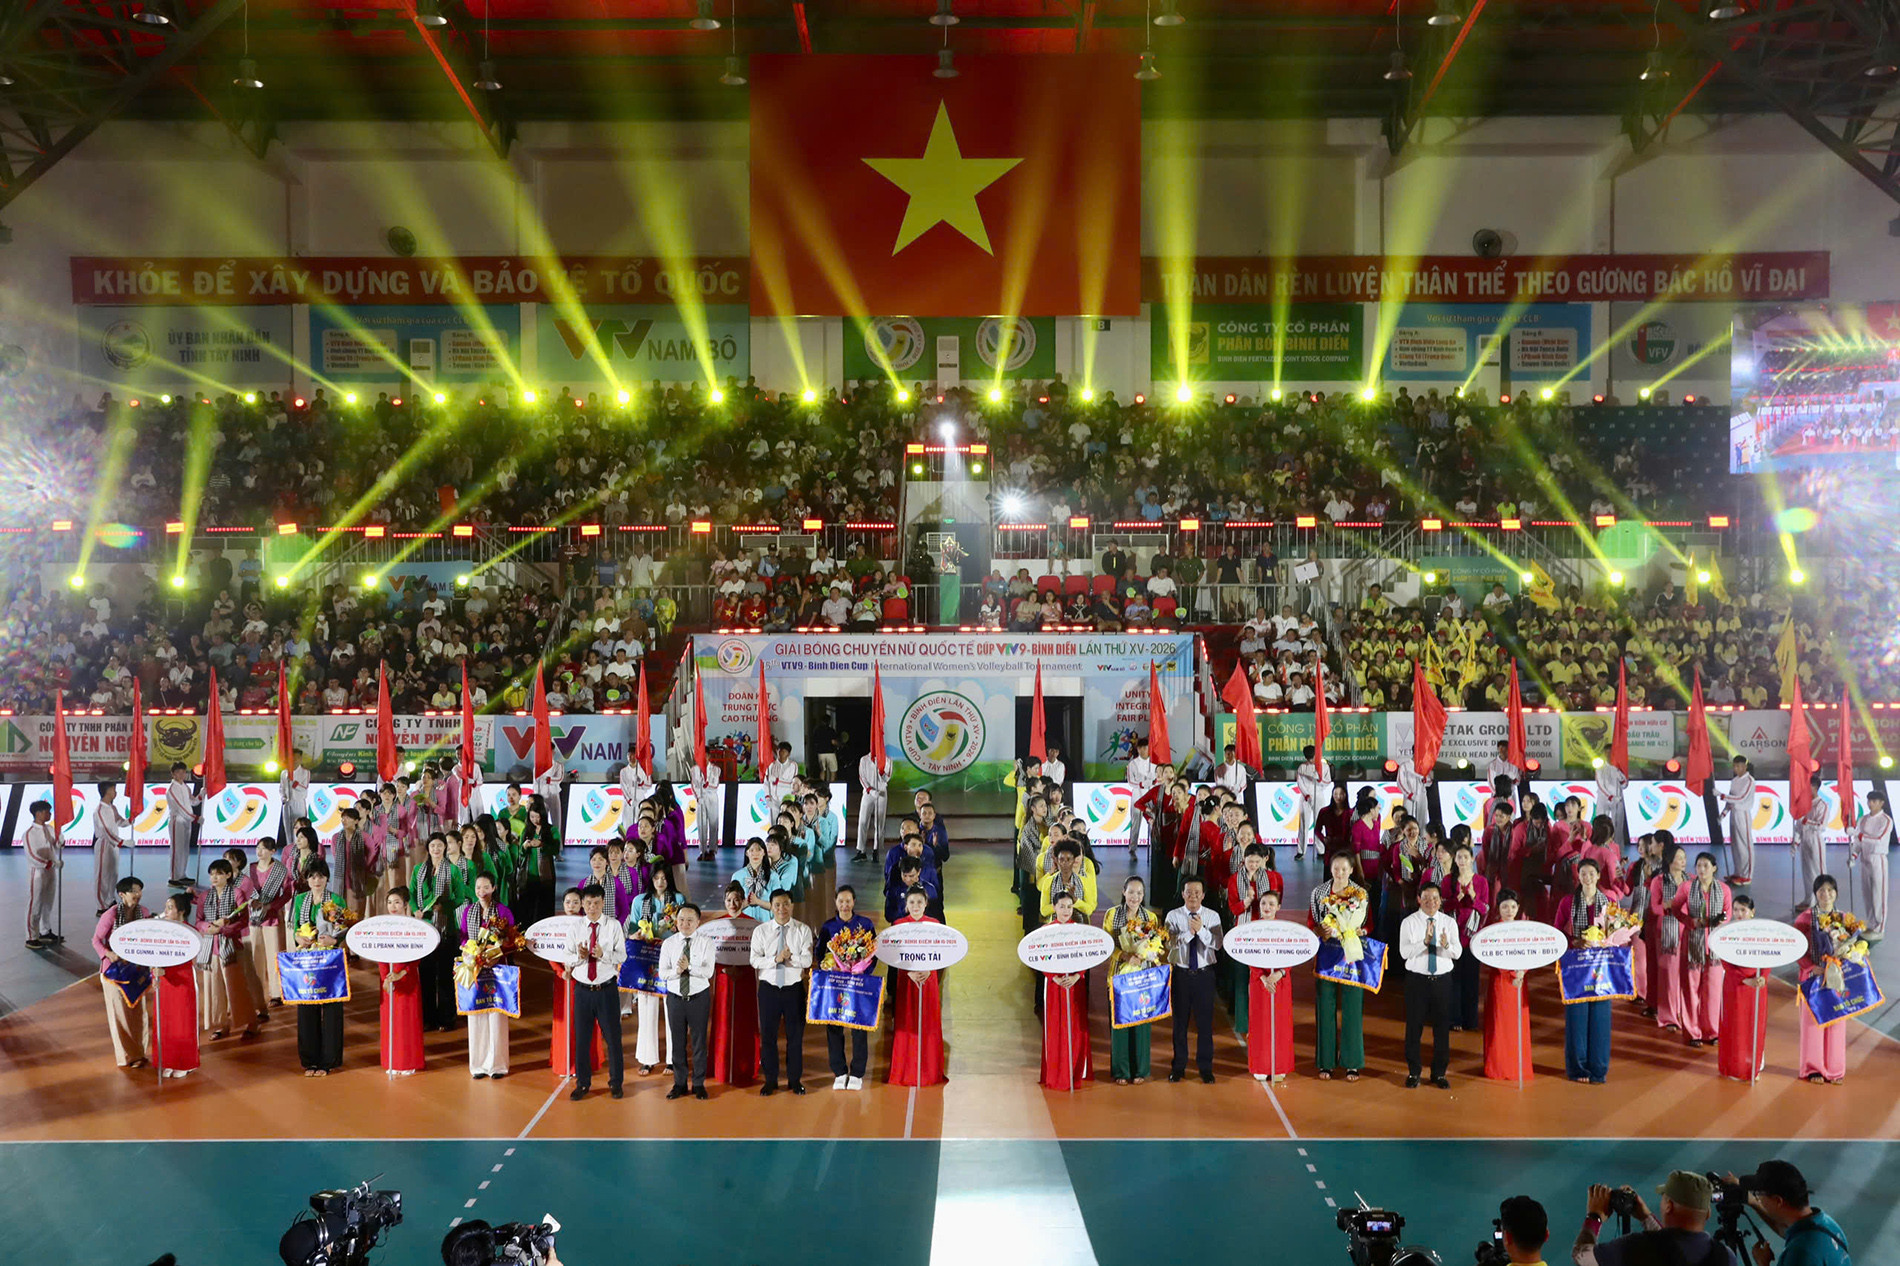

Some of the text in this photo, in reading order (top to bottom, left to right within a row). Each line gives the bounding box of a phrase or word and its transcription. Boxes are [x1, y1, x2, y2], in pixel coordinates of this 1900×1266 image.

[94, 262, 181, 295] KHỎE
[193, 259, 237, 295] ĐỂ
[249, 264, 310, 295] XÂY
[323, 266, 410, 300] DỰNG
[419, 264, 461, 295] VÀ
[473, 260, 538, 295] BẢO
[601, 259, 643, 295] TỔ
[1224, 266, 1268, 296] DÂN
[1275, 266, 1319, 296] RÈN
[1325, 265, 1393, 299] LUYỆN
[1401, 265, 1458, 296] THÂN
[1464, 259, 1507, 295] THỂ
[1514, 270, 1571, 295] THEO
[1576, 266, 1647, 295] GƯƠNG
[1654, 264, 1697, 294] BÁC
[1703, 259, 1734, 293] HỒ
[1740, 263, 1764, 292] VĨ
[1768, 268, 1806, 297] ĐẠI
[1217, 321, 1258, 333] CÔNG
[1263, 323, 1281, 333] TY
[186, 331, 209, 345] BAN
[1217, 334, 1252, 351] PHÂN
[648, 339, 696, 361] NAM
[708, 334, 737, 364] BỘ
[232, 349, 260, 362] NINH
[775, 640, 801, 656] GIẢI
[803, 640, 841, 656] BÓNG
[843, 638, 896, 656] CHUYỀN
[898, 640, 917, 656] NỮ
[919, 638, 957, 656] QUỐC
[959, 638, 974, 656] TẾ
[976, 640, 995, 656] CÚP
[1055, 639, 1077, 656] ĐIỀN
[1079, 638, 1101, 656] LẦN
[1104, 640, 1129, 656] THỨ
[829, 661, 850, 671] Dien
[850, 661, 869, 674] Cup
[932, 661, 976, 672] Women's
[976, 660, 1024, 675] Volleyball
[1024, 661, 1083, 672] Tornament
[728, 691, 771, 700] ĐOÀN KT
[1125, 690, 1151, 699] UNITY
[722, 703, 752, 711] TRUNG
[1115, 702, 1151, 710] INTEGRI
[365, 718, 461, 729] CG TY TNHH
[721, 714, 740, 723] CAO
[1116, 714, 1136, 722] FAIR
[66, 722, 77, 732] TY
[79, 722, 103, 732] TNHH
[1268, 721, 1305, 734] CÔNG
[1443, 724, 1475, 735] ETAK
[1527, 724, 1553, 735] LTD
[965, 740, 979, 758] 2026
[1268, 735, 1297, 751] PHÂN
[1325, 735, 1351, 751] BÌNH
[1739, 740, 1787, 748] GARSON
[582, 742, 622, 761] NAM
[942, 761, 963, 771] NINH
[900, 951, 941, 964] TRỌNG TÀI
[1295, 947, 1312, 956] QUỐC
